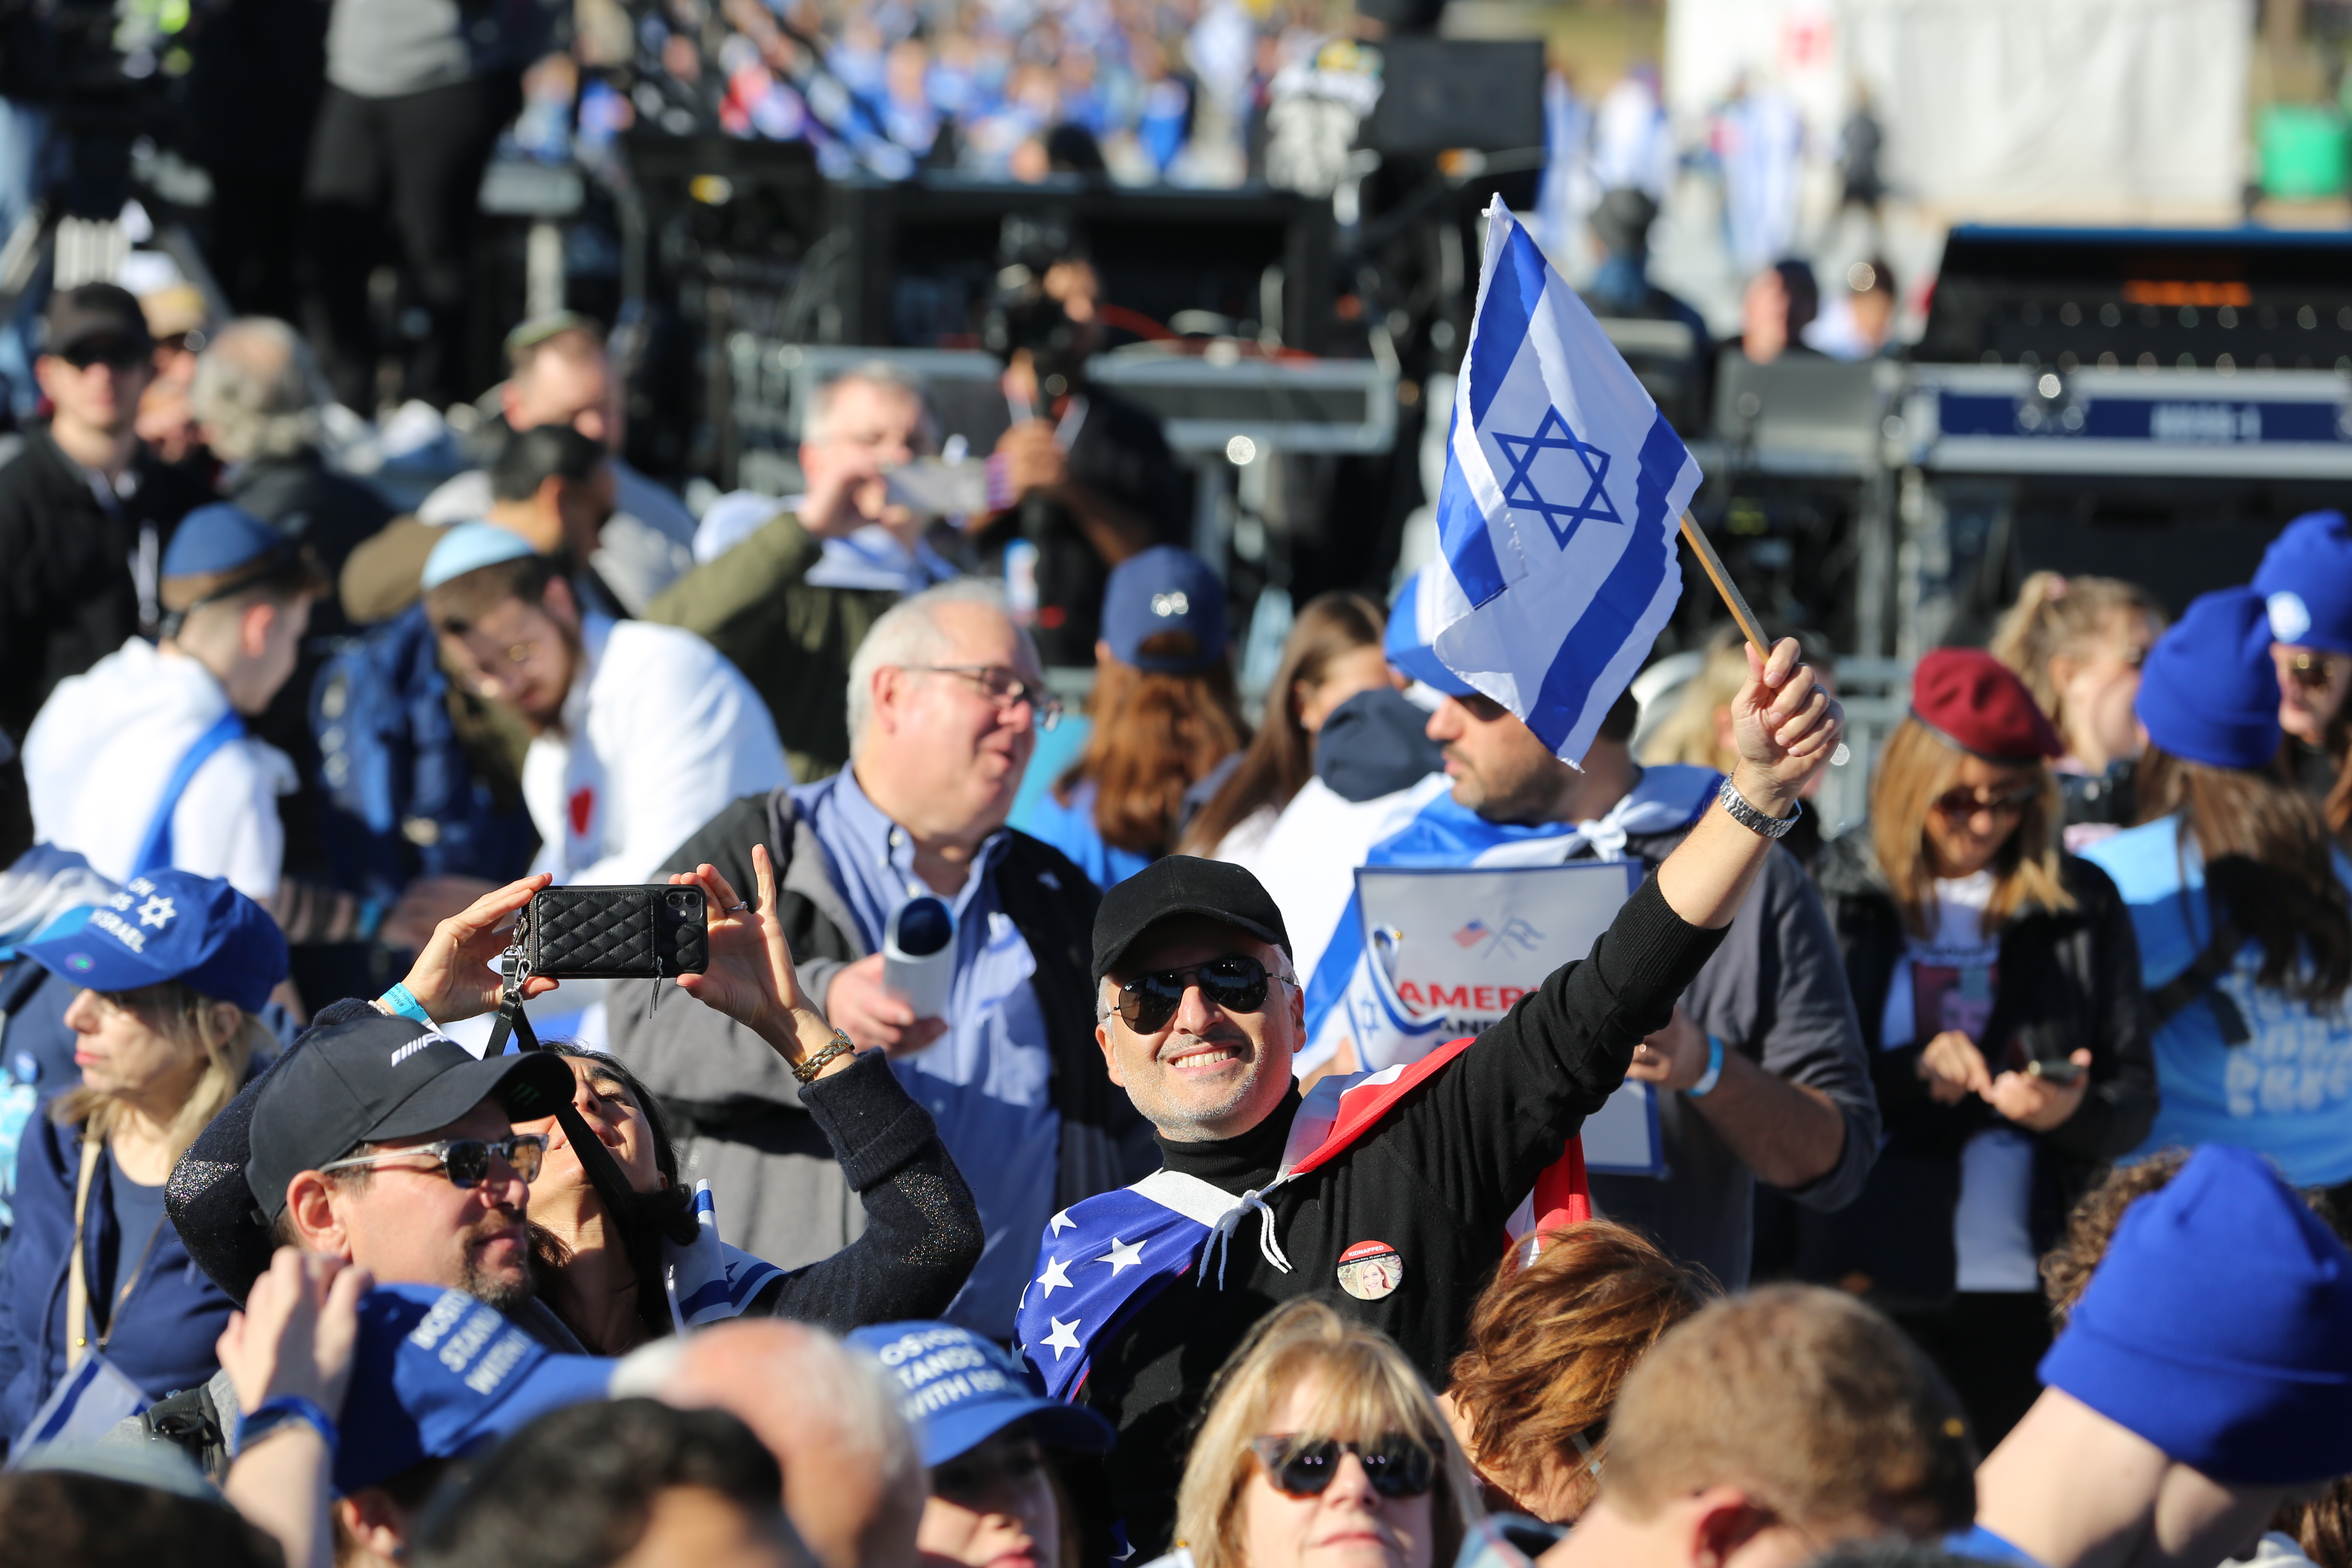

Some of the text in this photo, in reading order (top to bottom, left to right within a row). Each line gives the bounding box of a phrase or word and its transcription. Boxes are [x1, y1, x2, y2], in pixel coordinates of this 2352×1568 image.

[1397, 980, 1539, 1011] AMER
[1348, 1245, 1384, 1257] KIDNAPPED
[408, 1287, 474, 1351] BOSTO
[438, 1305, 503, 1373] STAND
[879, 1326, 973, 1366] OSTON
[896, 1344, 987, 1390] TANDS
